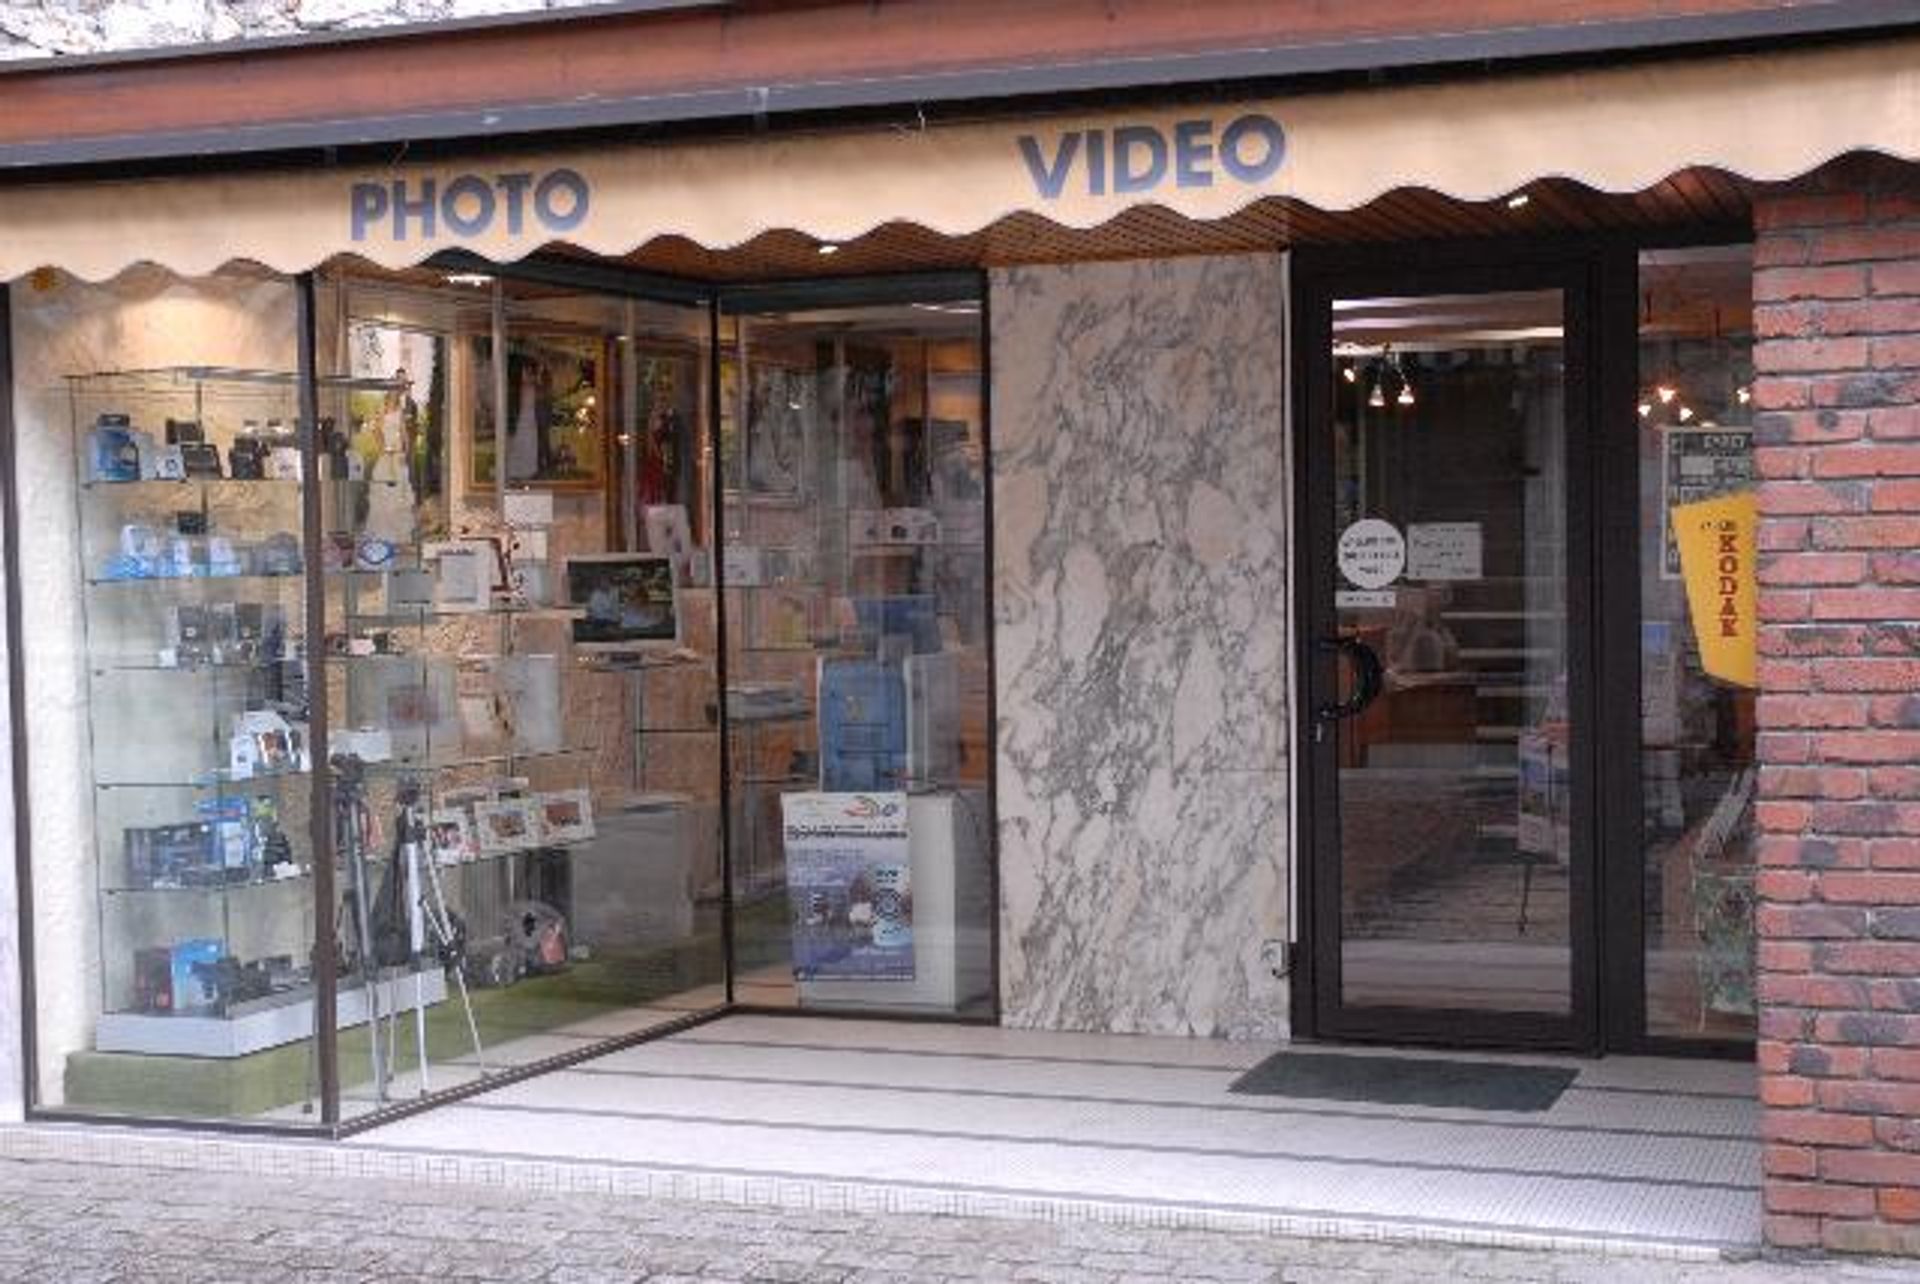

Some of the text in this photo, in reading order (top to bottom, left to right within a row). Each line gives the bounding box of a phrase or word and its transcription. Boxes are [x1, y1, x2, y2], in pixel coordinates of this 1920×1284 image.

[351, 114, 1286, 241] PHOTO VIDEO
[1719, 534, 1739, 637] KODAK
